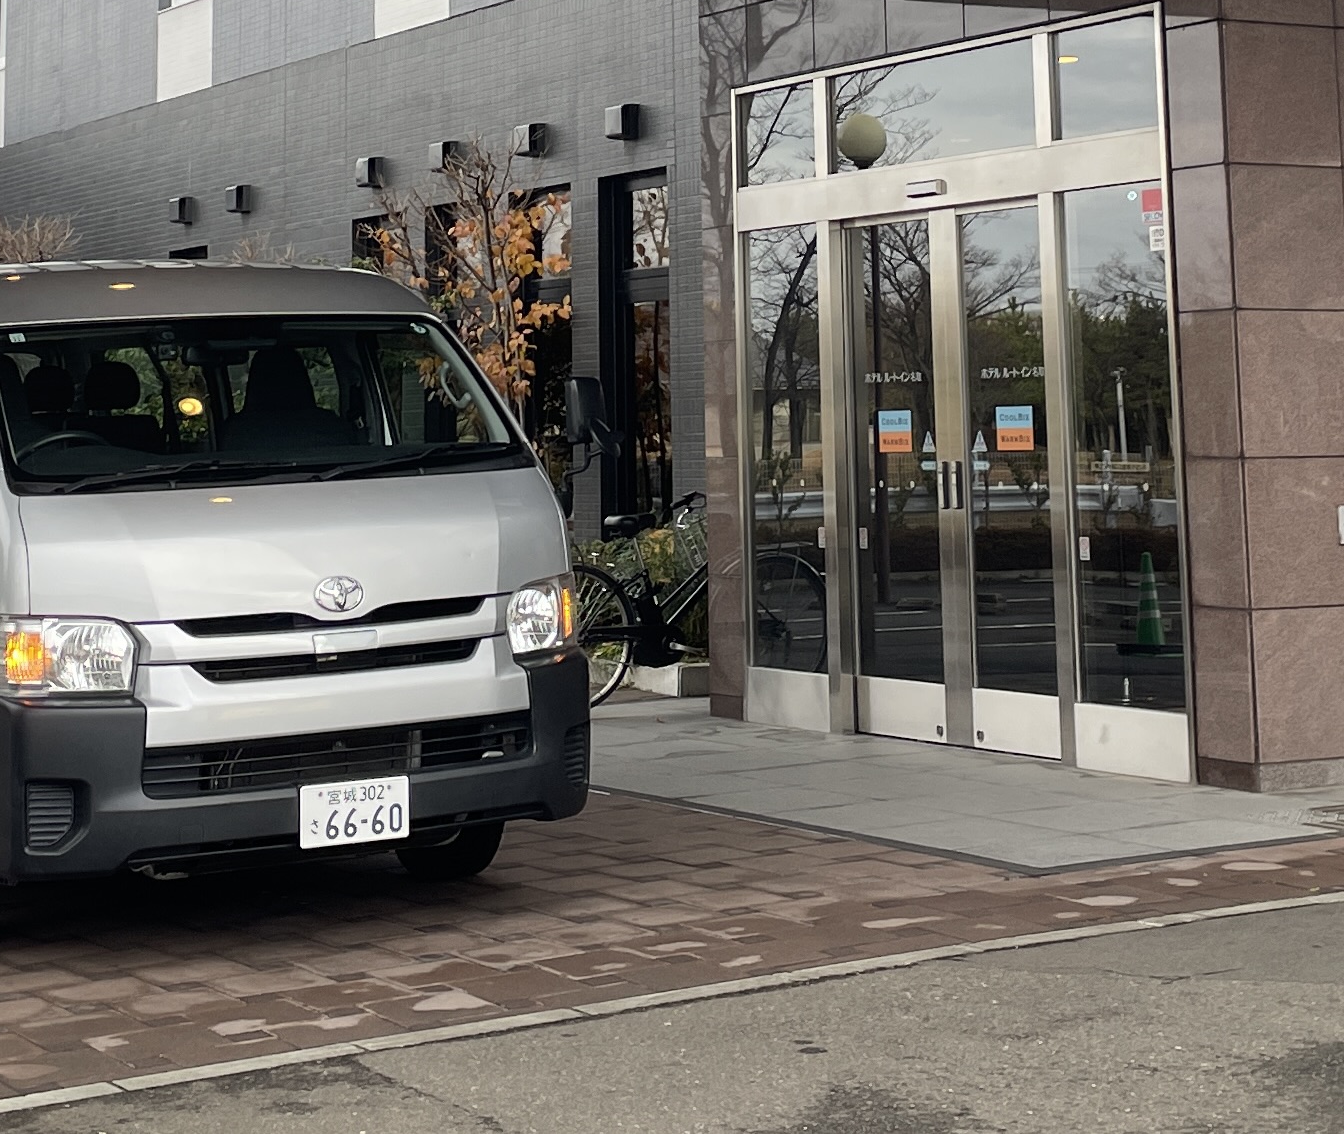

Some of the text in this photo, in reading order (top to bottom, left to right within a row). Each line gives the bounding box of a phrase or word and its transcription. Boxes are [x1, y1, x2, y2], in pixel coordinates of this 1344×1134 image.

[328, 784, 385, 805] 宮城 302
[325, 802, 403, 840] 66-60
